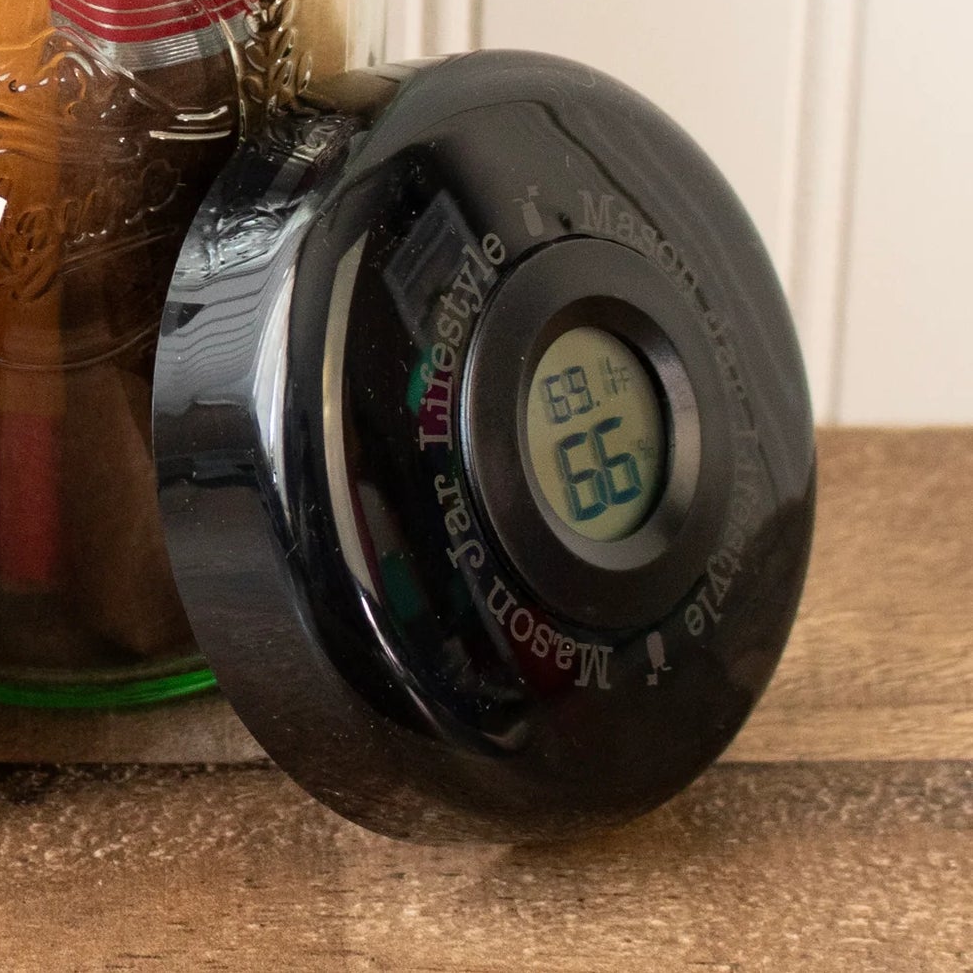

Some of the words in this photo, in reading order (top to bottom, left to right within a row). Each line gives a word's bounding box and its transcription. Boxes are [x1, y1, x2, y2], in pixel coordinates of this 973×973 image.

[578, 188, 702, 294] Mason
[418, 231, 508, 451] Lifestyle
[434, 473, 485, 570] Jar
[557, 416, 642, 521] 66
[485, 575, 615, 690] Mason
